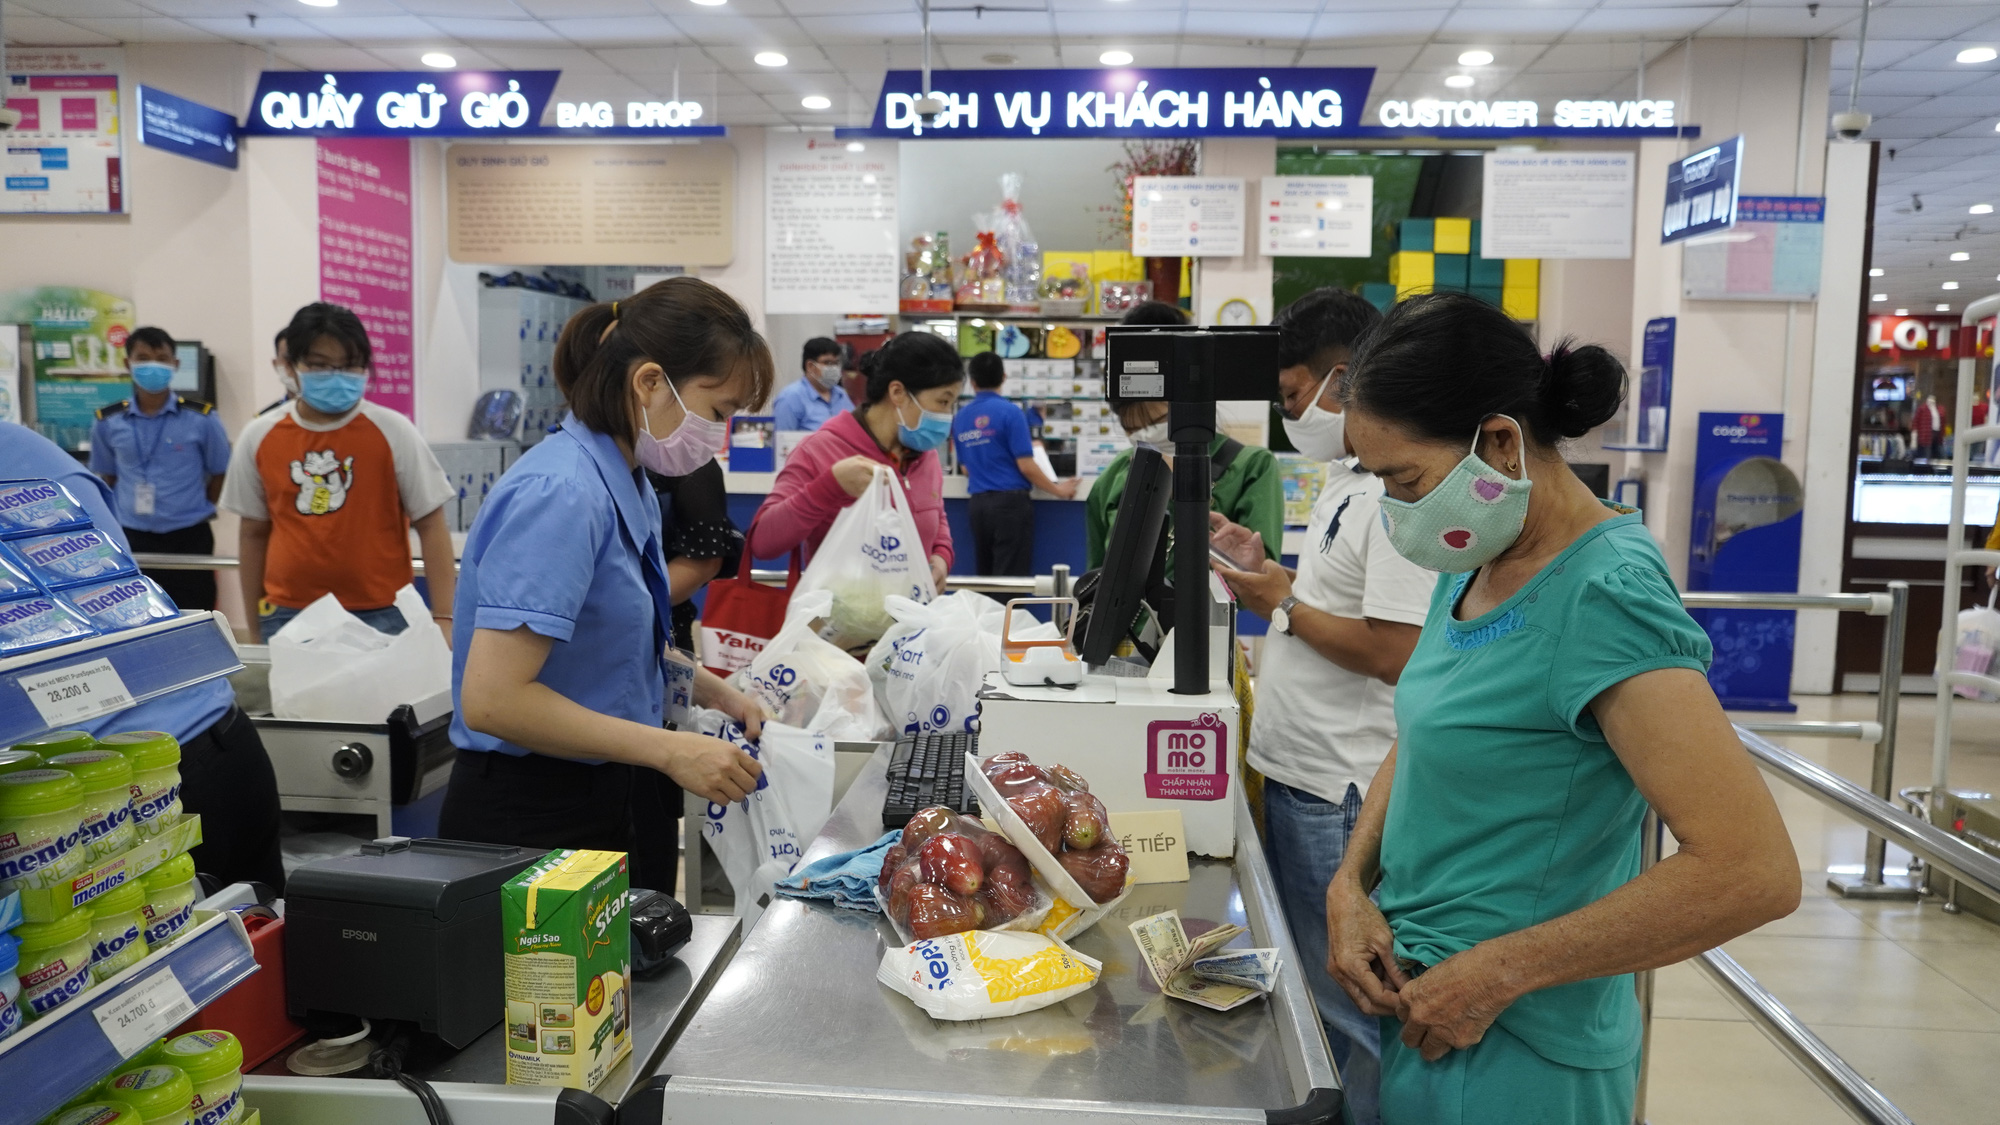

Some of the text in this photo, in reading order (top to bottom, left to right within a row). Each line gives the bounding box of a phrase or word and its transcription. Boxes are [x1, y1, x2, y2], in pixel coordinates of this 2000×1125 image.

[261, 74, 363, 129] QUẦY
[376, 83, 448, 128] GIỮ
[460, 79, 529, 129] GIỎ
[886, 76, 1342, 135] DỊCH VỤ KHÁCH HÀNG
[556, 102, 703, 128] BAG DROP
[1379, 100, 1675, 128] CUSTOMER SERVICE
[29, 533, 101, 565] mentos
[80, 580, 148, 615] mentos
[47, 682, 91, 703] 28.200 đ
[1168, 733, 1206, 749] mo
[1168, 751, 1206, 768] mo
[1162, 777, 1212, 788] CHẤP NHẬN
[1190, 787, 1214, 796] TOÁN
[1117, 832, 1176, 854] Ế TIẾP
[73, 871, 125, 907] mentos
[76, 878, 93, 890] GUM
[596, 870, 616, 890] VINAMILK
[596, 890, 628, 938] Star
[342, 929, 377, 942] EPSON
[520, 934, 560, 946] Ngôi Sao
[27, 961, 62, 979] CHEWING
[30, 966, 66, 985] GUM
[117, 1003, 148, 1028] 24.700
[513, 1054, 540, 1062] VINAMILK
